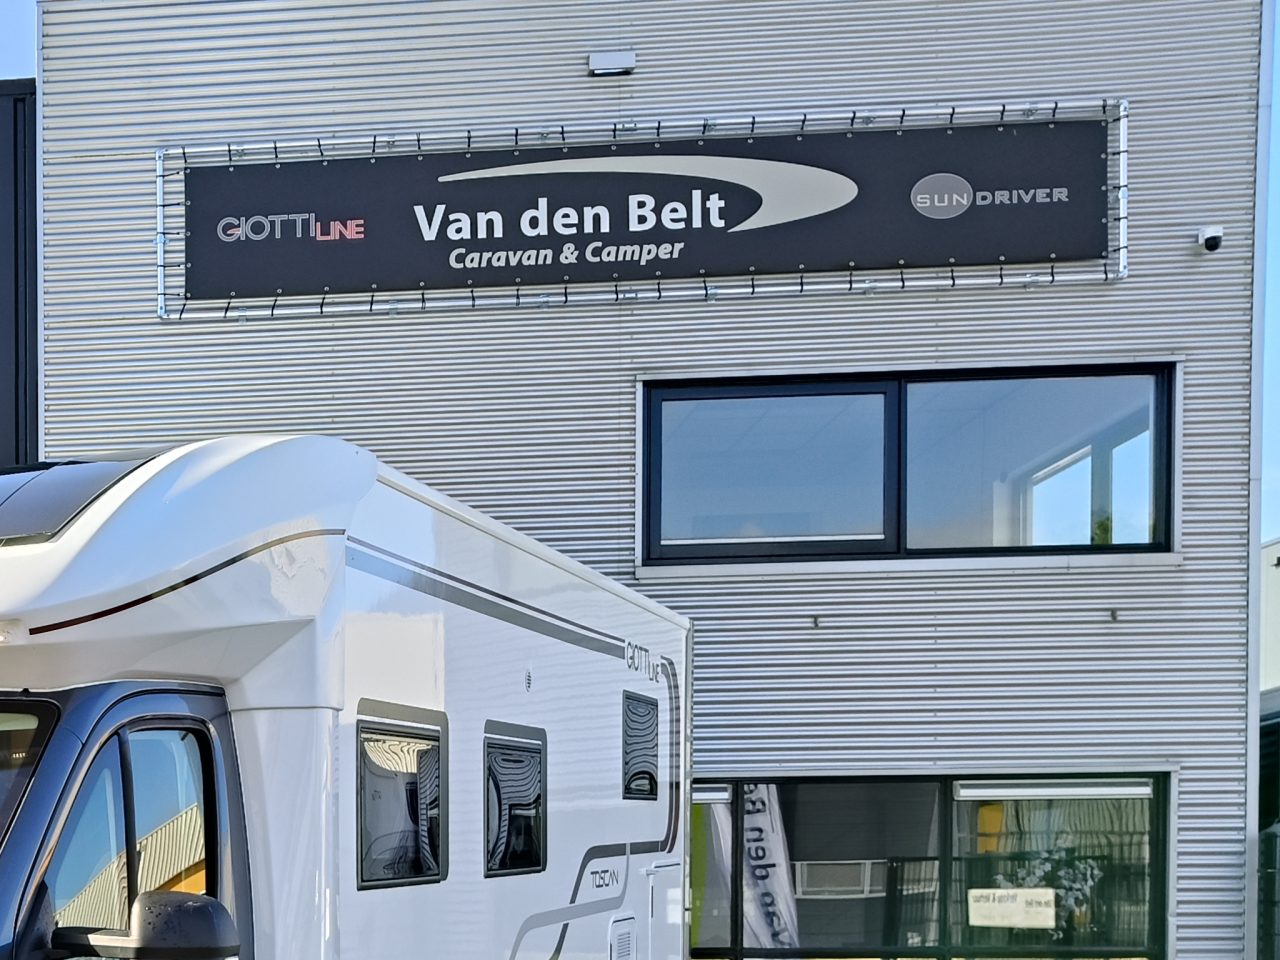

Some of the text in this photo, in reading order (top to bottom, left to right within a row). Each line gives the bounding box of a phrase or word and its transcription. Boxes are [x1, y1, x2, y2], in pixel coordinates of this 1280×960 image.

[413, 189, 726, 241] Van den Belt
[448, 240, 685, 269] Caravan & Camper
